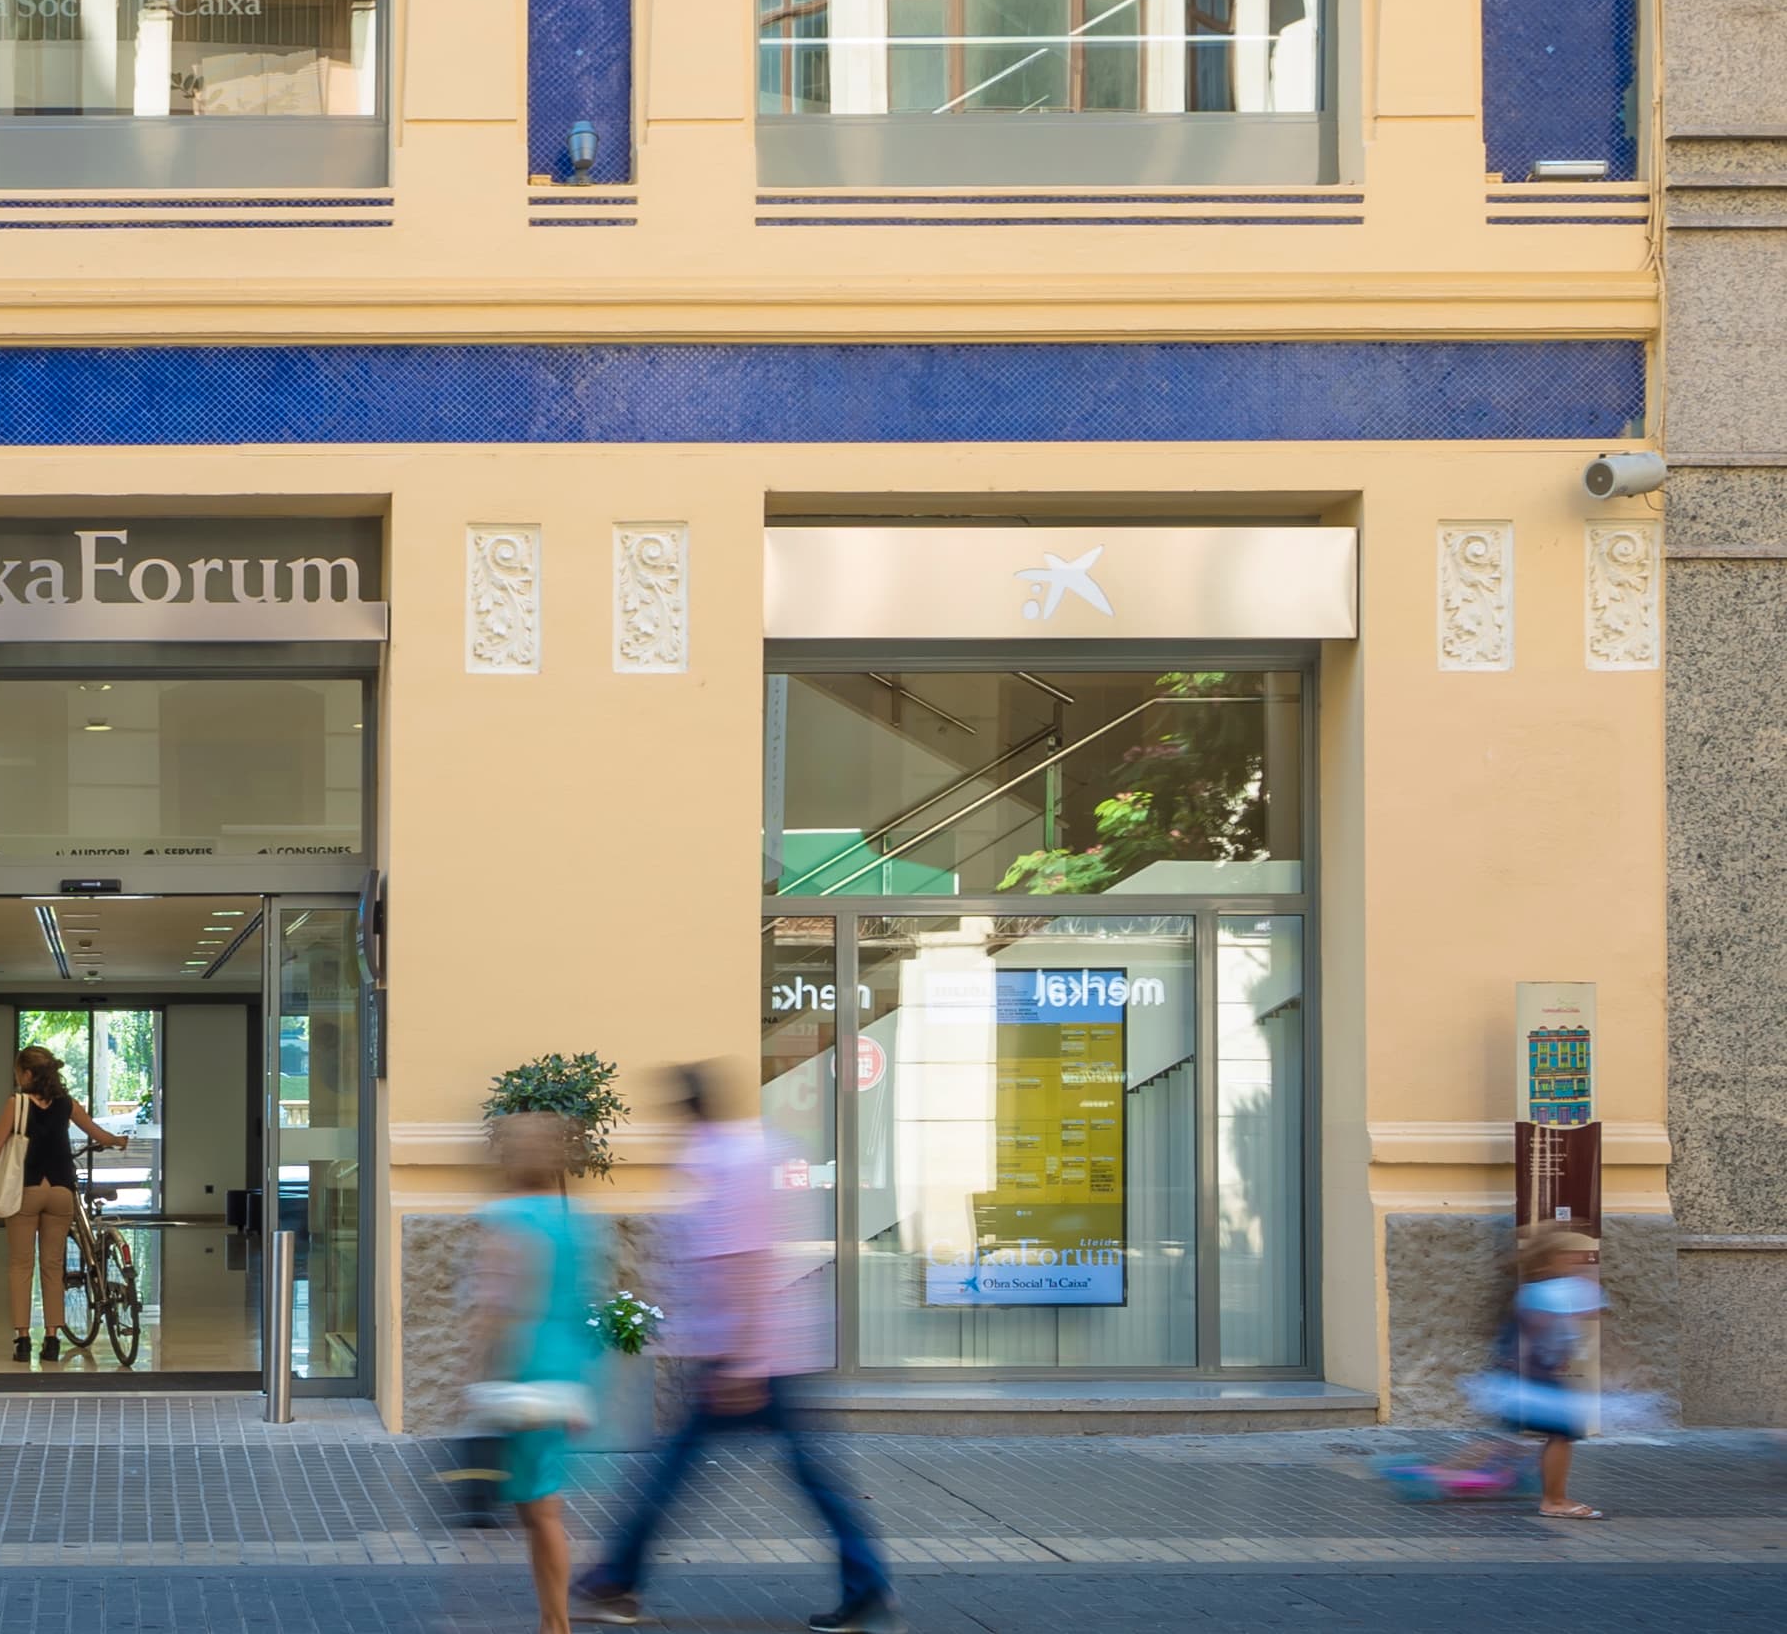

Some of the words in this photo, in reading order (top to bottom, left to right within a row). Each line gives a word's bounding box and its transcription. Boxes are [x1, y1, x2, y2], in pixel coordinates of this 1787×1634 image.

[927, 1237, 1123, 1268] CaixaForum
[982, 1278, 1011, 1289] Obra
[1011, 1277, 1043, 1289] Social
[1058, 1277, 1092, 1289] Caixa"
